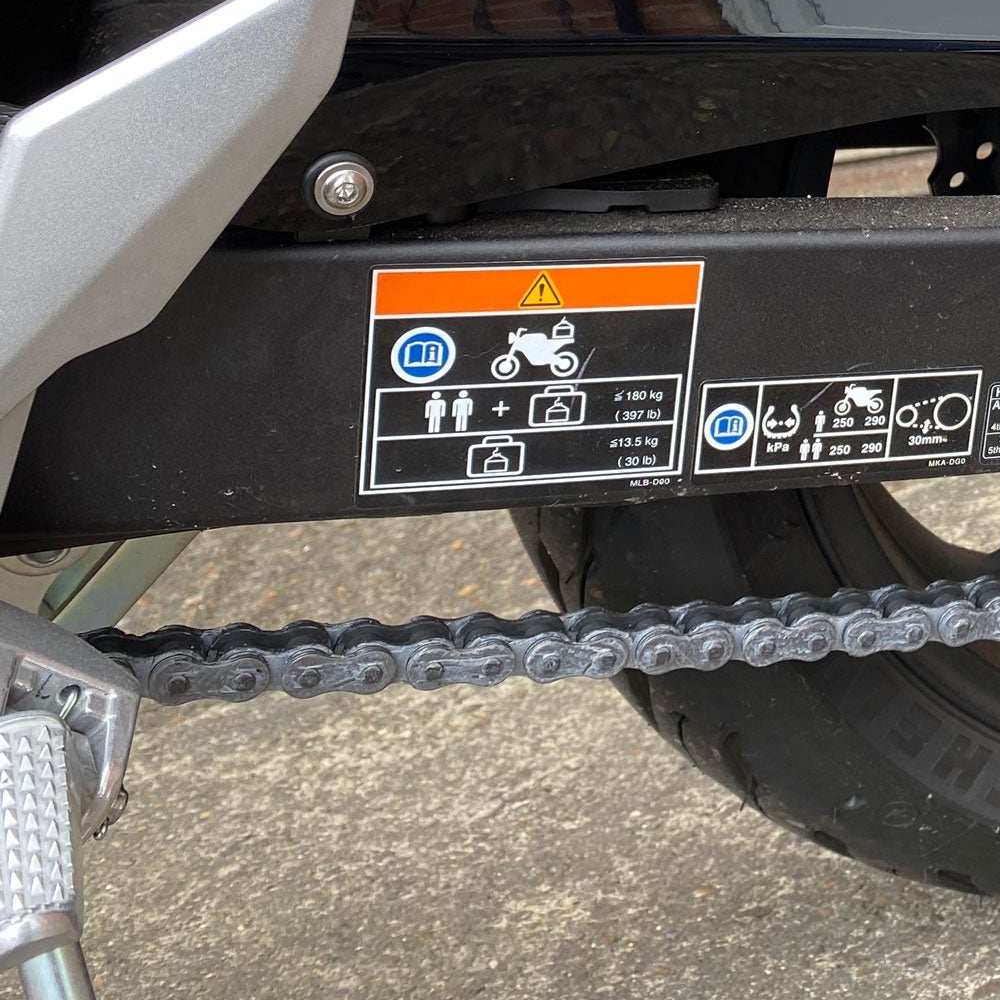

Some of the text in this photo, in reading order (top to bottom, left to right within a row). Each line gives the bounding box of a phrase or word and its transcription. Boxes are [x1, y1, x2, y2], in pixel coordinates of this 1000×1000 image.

[626, 391, 647, 401] 180
[649, 389, 664, 402] kg
[646, 408, 661, 420] lb)
[832, 415, 886, 428] 250 290
[645, 436, 659, 448] kg
[766, 442, 790, 453] kPa
[829, 442, 883, 456] 250 290
[642, 454, 657, 466] lb)
[928, 458, 967, 467] MKA-DG0
